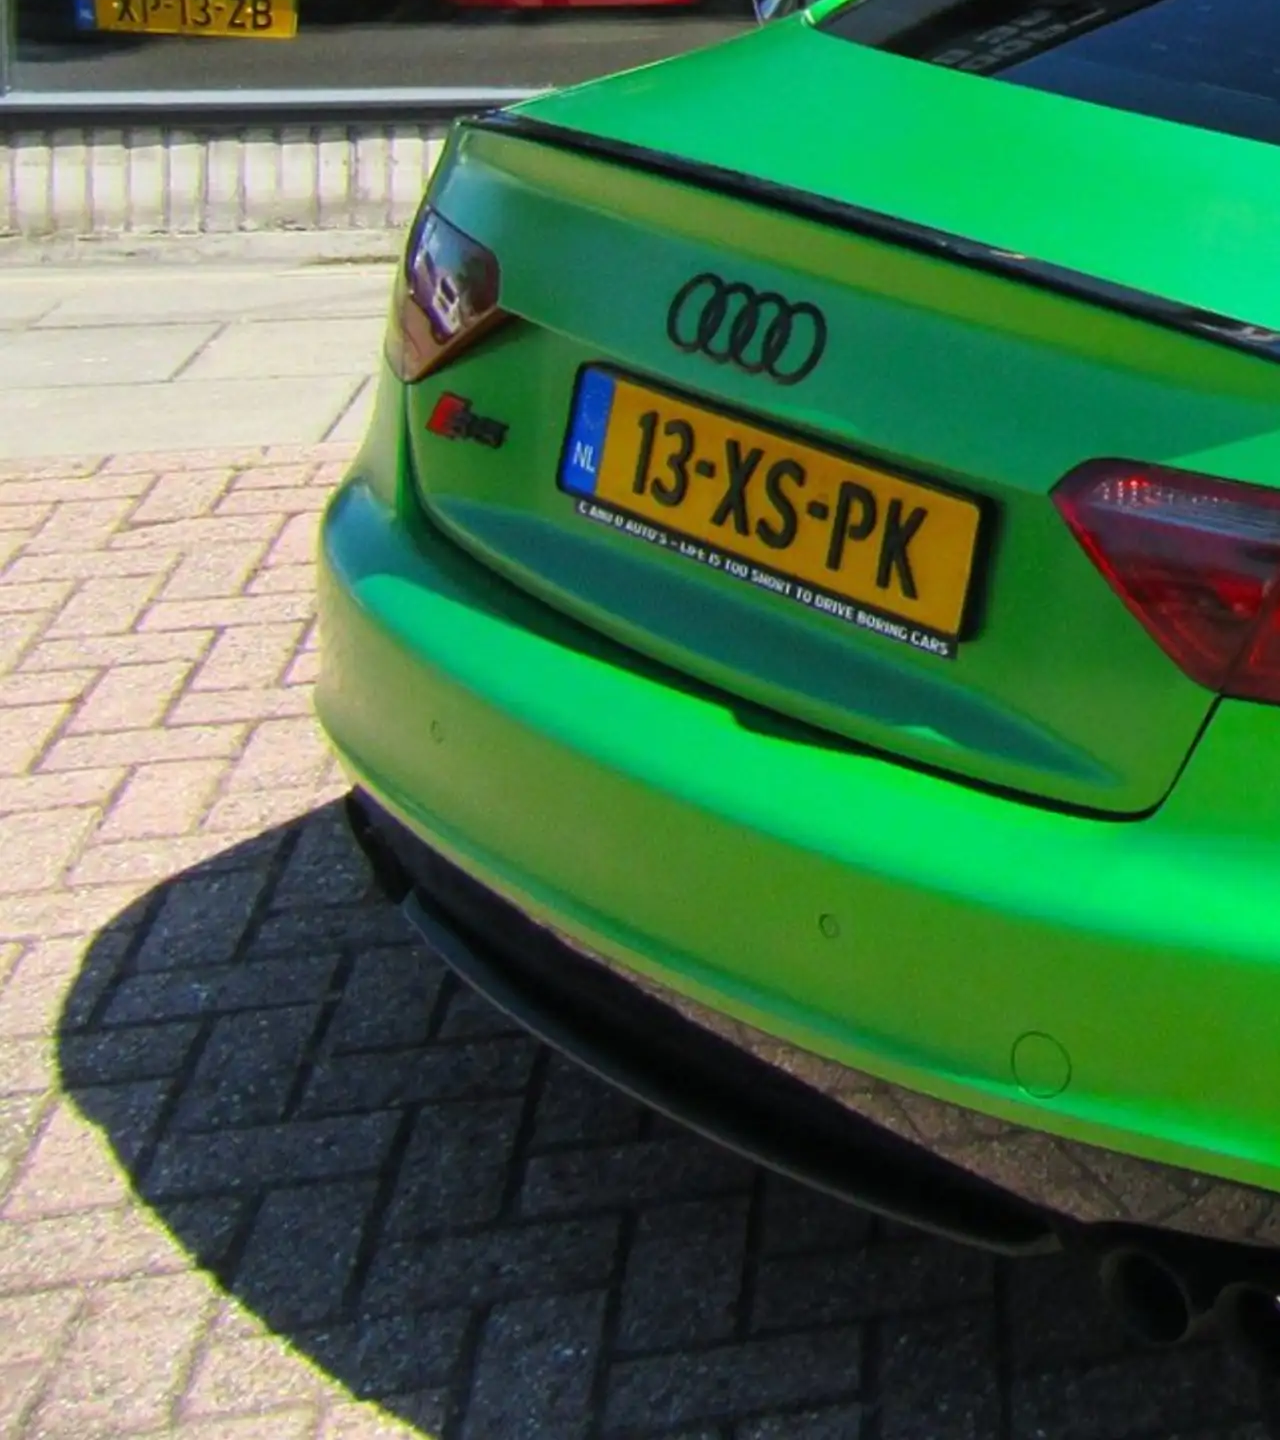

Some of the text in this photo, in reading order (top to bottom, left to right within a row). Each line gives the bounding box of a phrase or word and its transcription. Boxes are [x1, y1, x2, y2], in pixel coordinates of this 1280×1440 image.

[572, 440, 596, 474] NL
[631, 409, 929, 600] 13-XS-PK
[708, 552, 722, 568] IS
[725, 560, 748, 578] TOO
[752, 569, 791, 596] SHORT
[795, 586, 813, 604] TO
[814, 594, 855, 620] DRIVE
[856, 610, 908, 641] BORING
[910, 631, 950, 657] CARS
